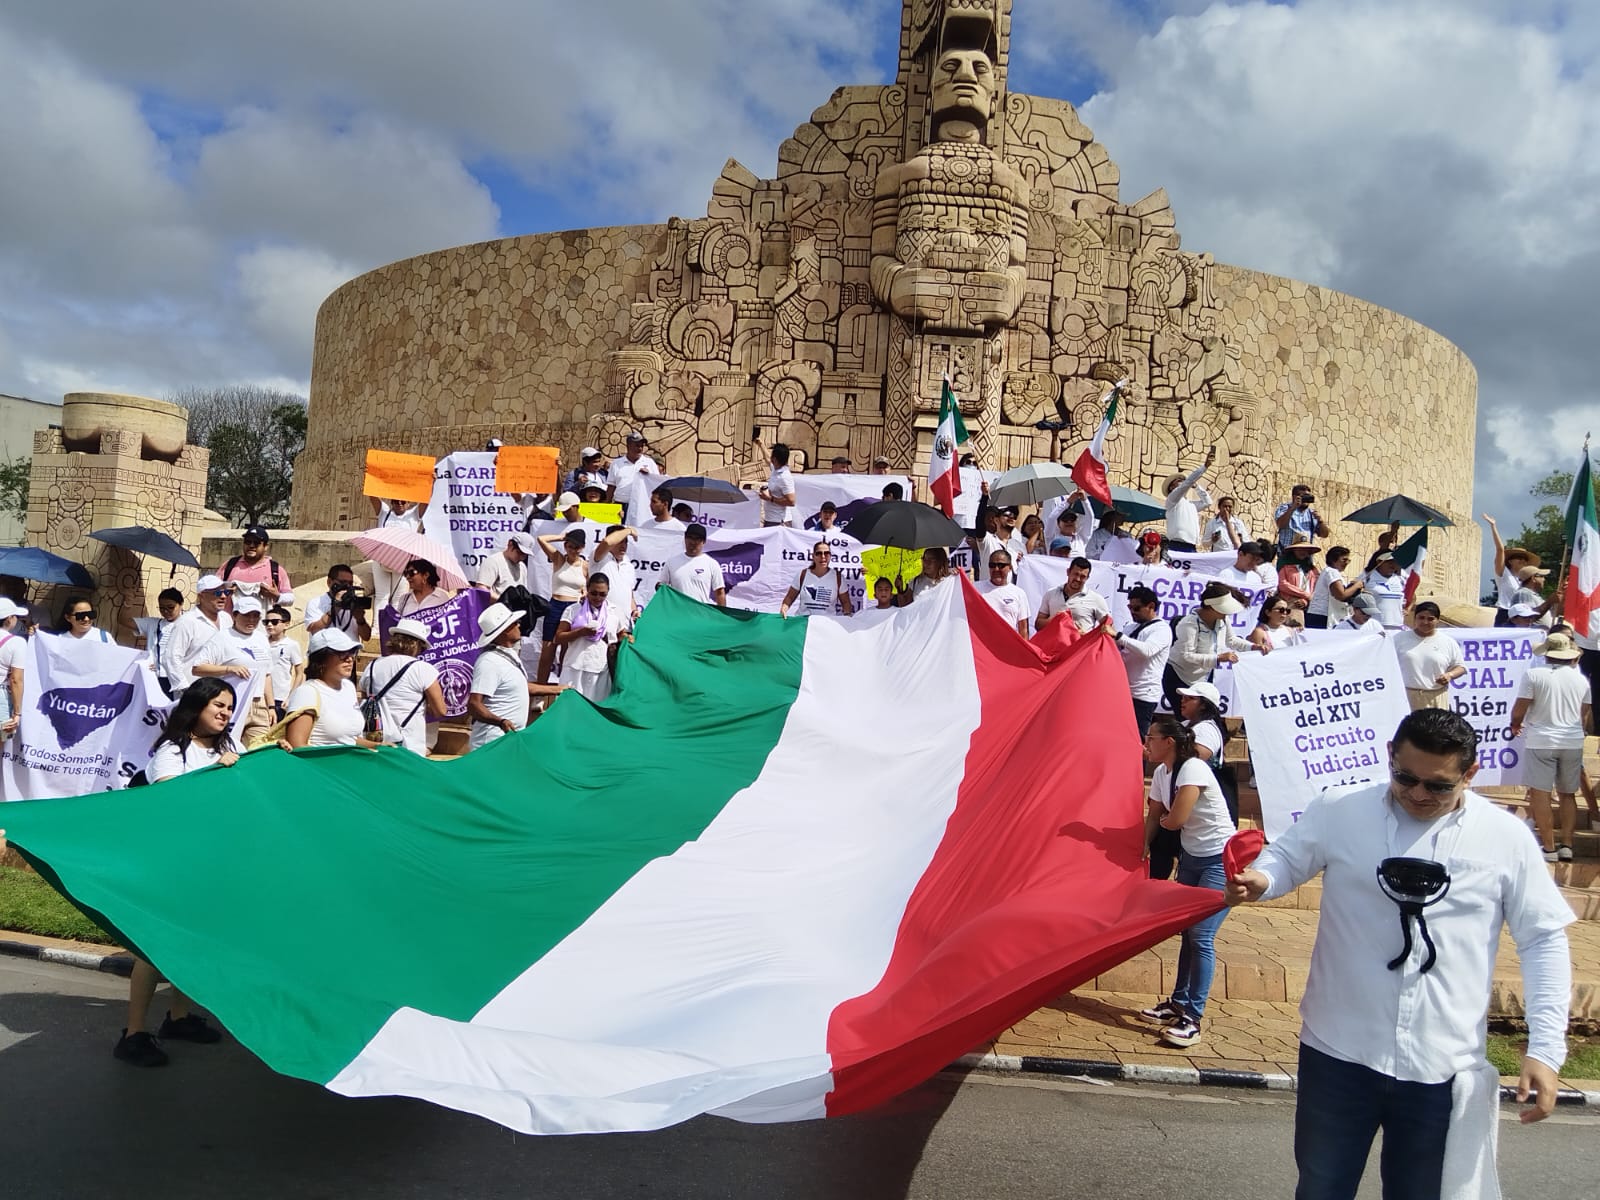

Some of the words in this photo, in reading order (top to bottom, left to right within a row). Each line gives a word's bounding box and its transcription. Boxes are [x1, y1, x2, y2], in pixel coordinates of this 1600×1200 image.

[443, 502, 507, 515] también
[690, 512, 726, 528] oder
[472, 537, 494, 549] DE
[720, 561, 753, 574] atán
[1462, 639, 1533, 662] RERA
[1300, 661, 1335, 679] Los
[1260, 677, 1386, 709] trabajadores
[49, 694, 117, 719] Yucatán
[1295, 707, 1325, 728] del
[1326, 701, 1361, 723] XIV
[1295, 726, 1376, 753] Circuito
[1302, 747, 1380, 780] Judicial
